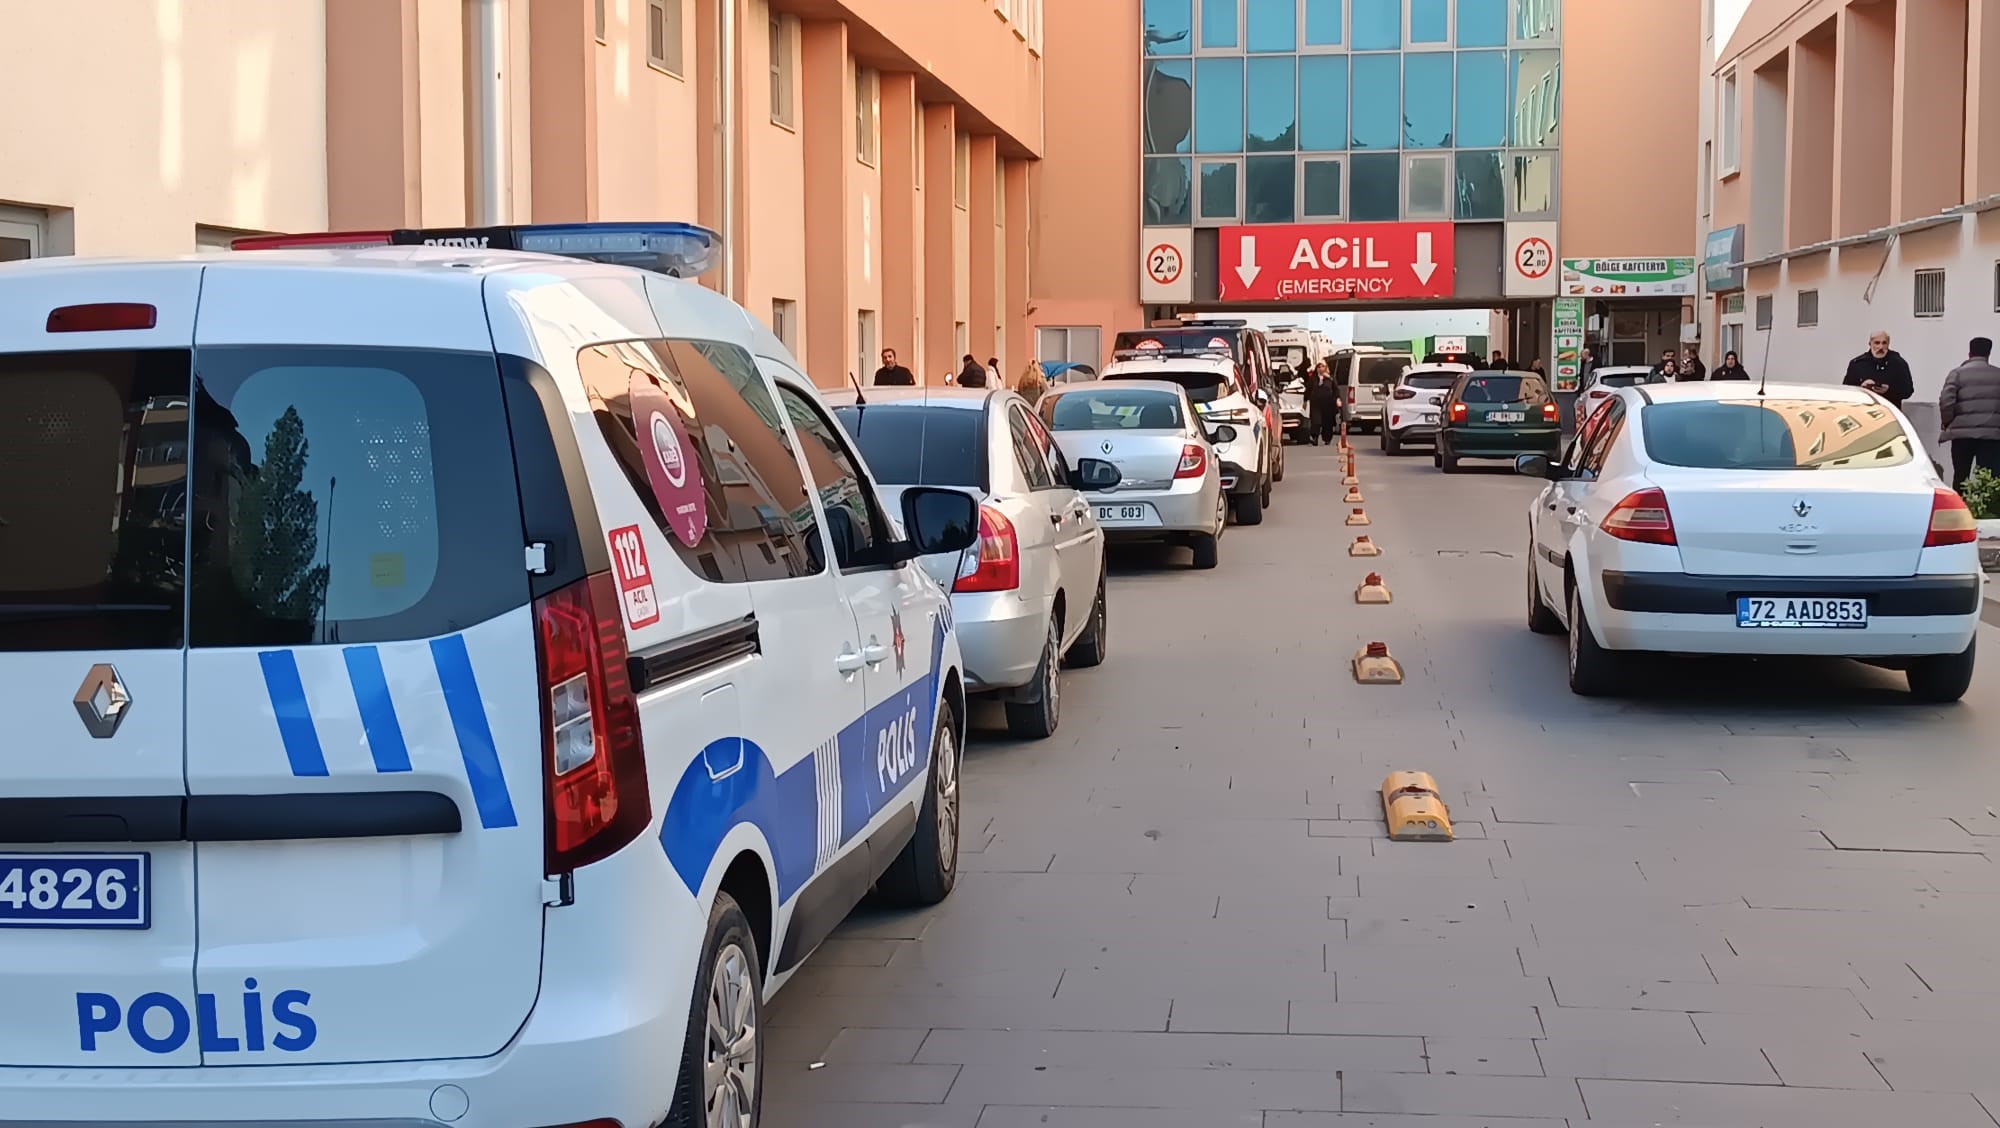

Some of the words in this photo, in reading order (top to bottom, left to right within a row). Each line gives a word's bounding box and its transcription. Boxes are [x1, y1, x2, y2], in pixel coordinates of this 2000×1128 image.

[1153, 256, 1165, 273] 2
[1523, 249, 1534, 267] 2
[1099, 507, 1113, 519] DC
[615, 530, 646, 580] 112
[1751, 600, 1776, 619] 72
[1785, 600, 1863, 620] AAD853
[877, 692, 916, 793] POLİS
[0, 868, 127, 910] 4826
[76, 977, 317, 1053] POLİS
